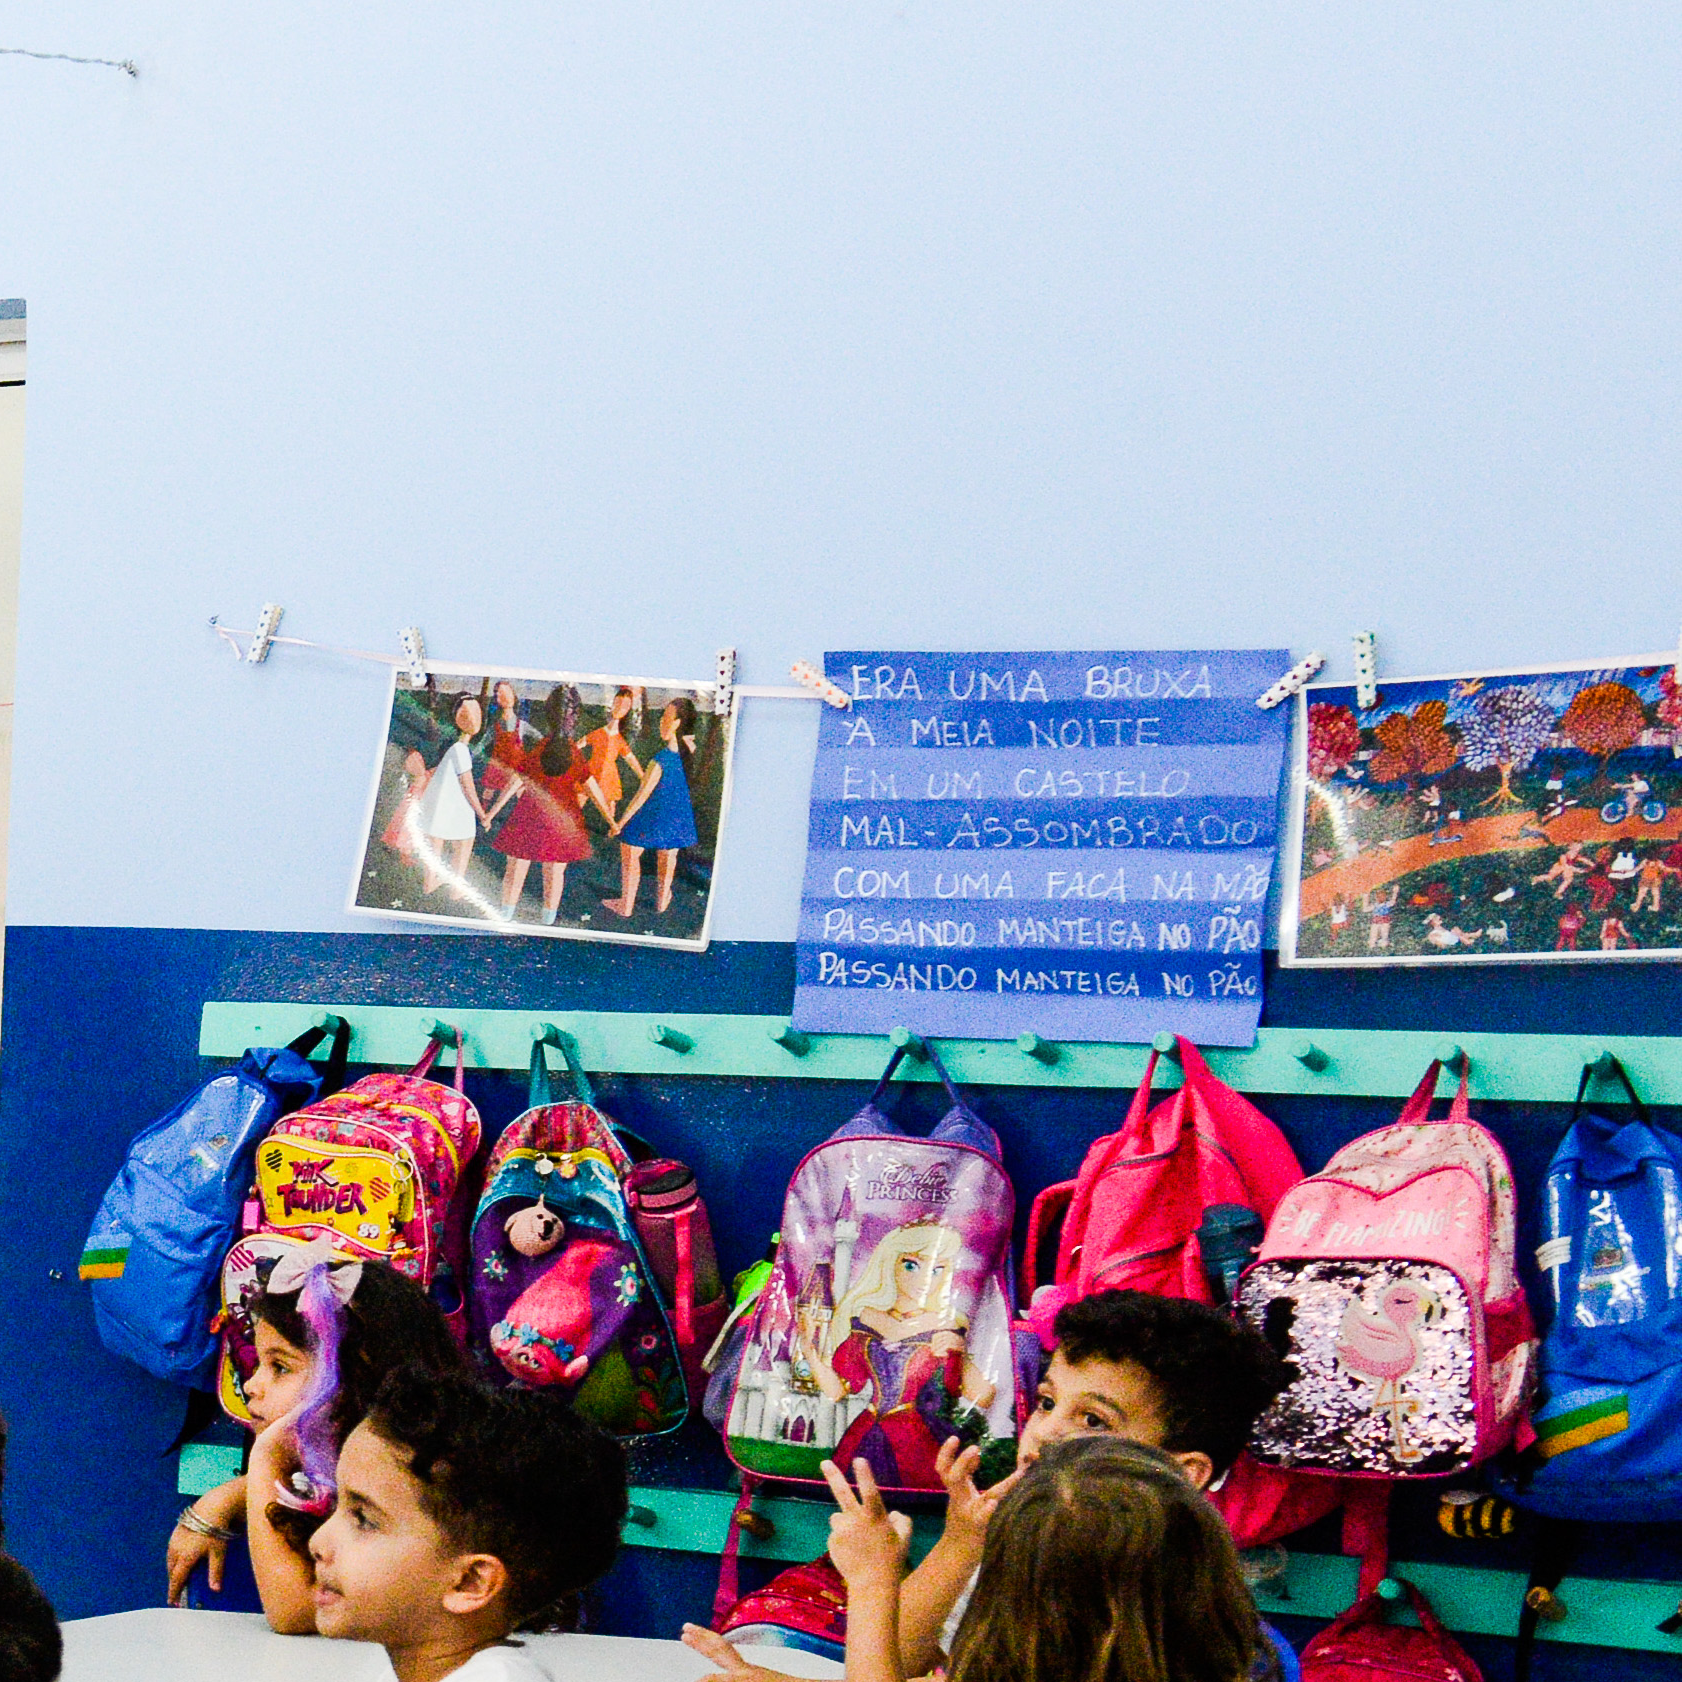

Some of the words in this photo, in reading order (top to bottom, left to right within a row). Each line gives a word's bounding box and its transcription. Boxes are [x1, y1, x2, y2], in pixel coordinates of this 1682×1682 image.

[851, 665, 922, 702] ERA
[948, 669, 1048, 703] UMA
[1085, 665, 1212, 700] BRUXA
[911, 716, 995, 747] MEIA
[1029, 717, 1161, 749] NOITE
[842, 766, 898, 800] EM
[927, 771, 982, 800] UM
[1016, 768, 1191, 798] CASTELO
[833, 866, 911, 900] COM
[934, 870, 1014, 899] UMA
[1046, 869, 1127, 903] FACA
[1153, 871, 1195, 899] NA
[822, 908, 977, 948] PASSANDO
[997, 916, 1146, 949] MANTEIGA
[1158, 921, 1192, 950] NO
[1208, 906, 1262, 954] PÃO
[818, 951, 978, 991] PASSANDO
[996, 966, 1141, 997] MANTEIGA
[1164, 970, 1194, 996] NO
[1208, 961, 1257, 997] PÃO
[277, 1182, 367, 1217] THUNDER
[866, 1181, 958, 1204] PRINCESS
[357, 1223, 380, 1239] 89
[1292, 1209, 1322, 1238] BE
